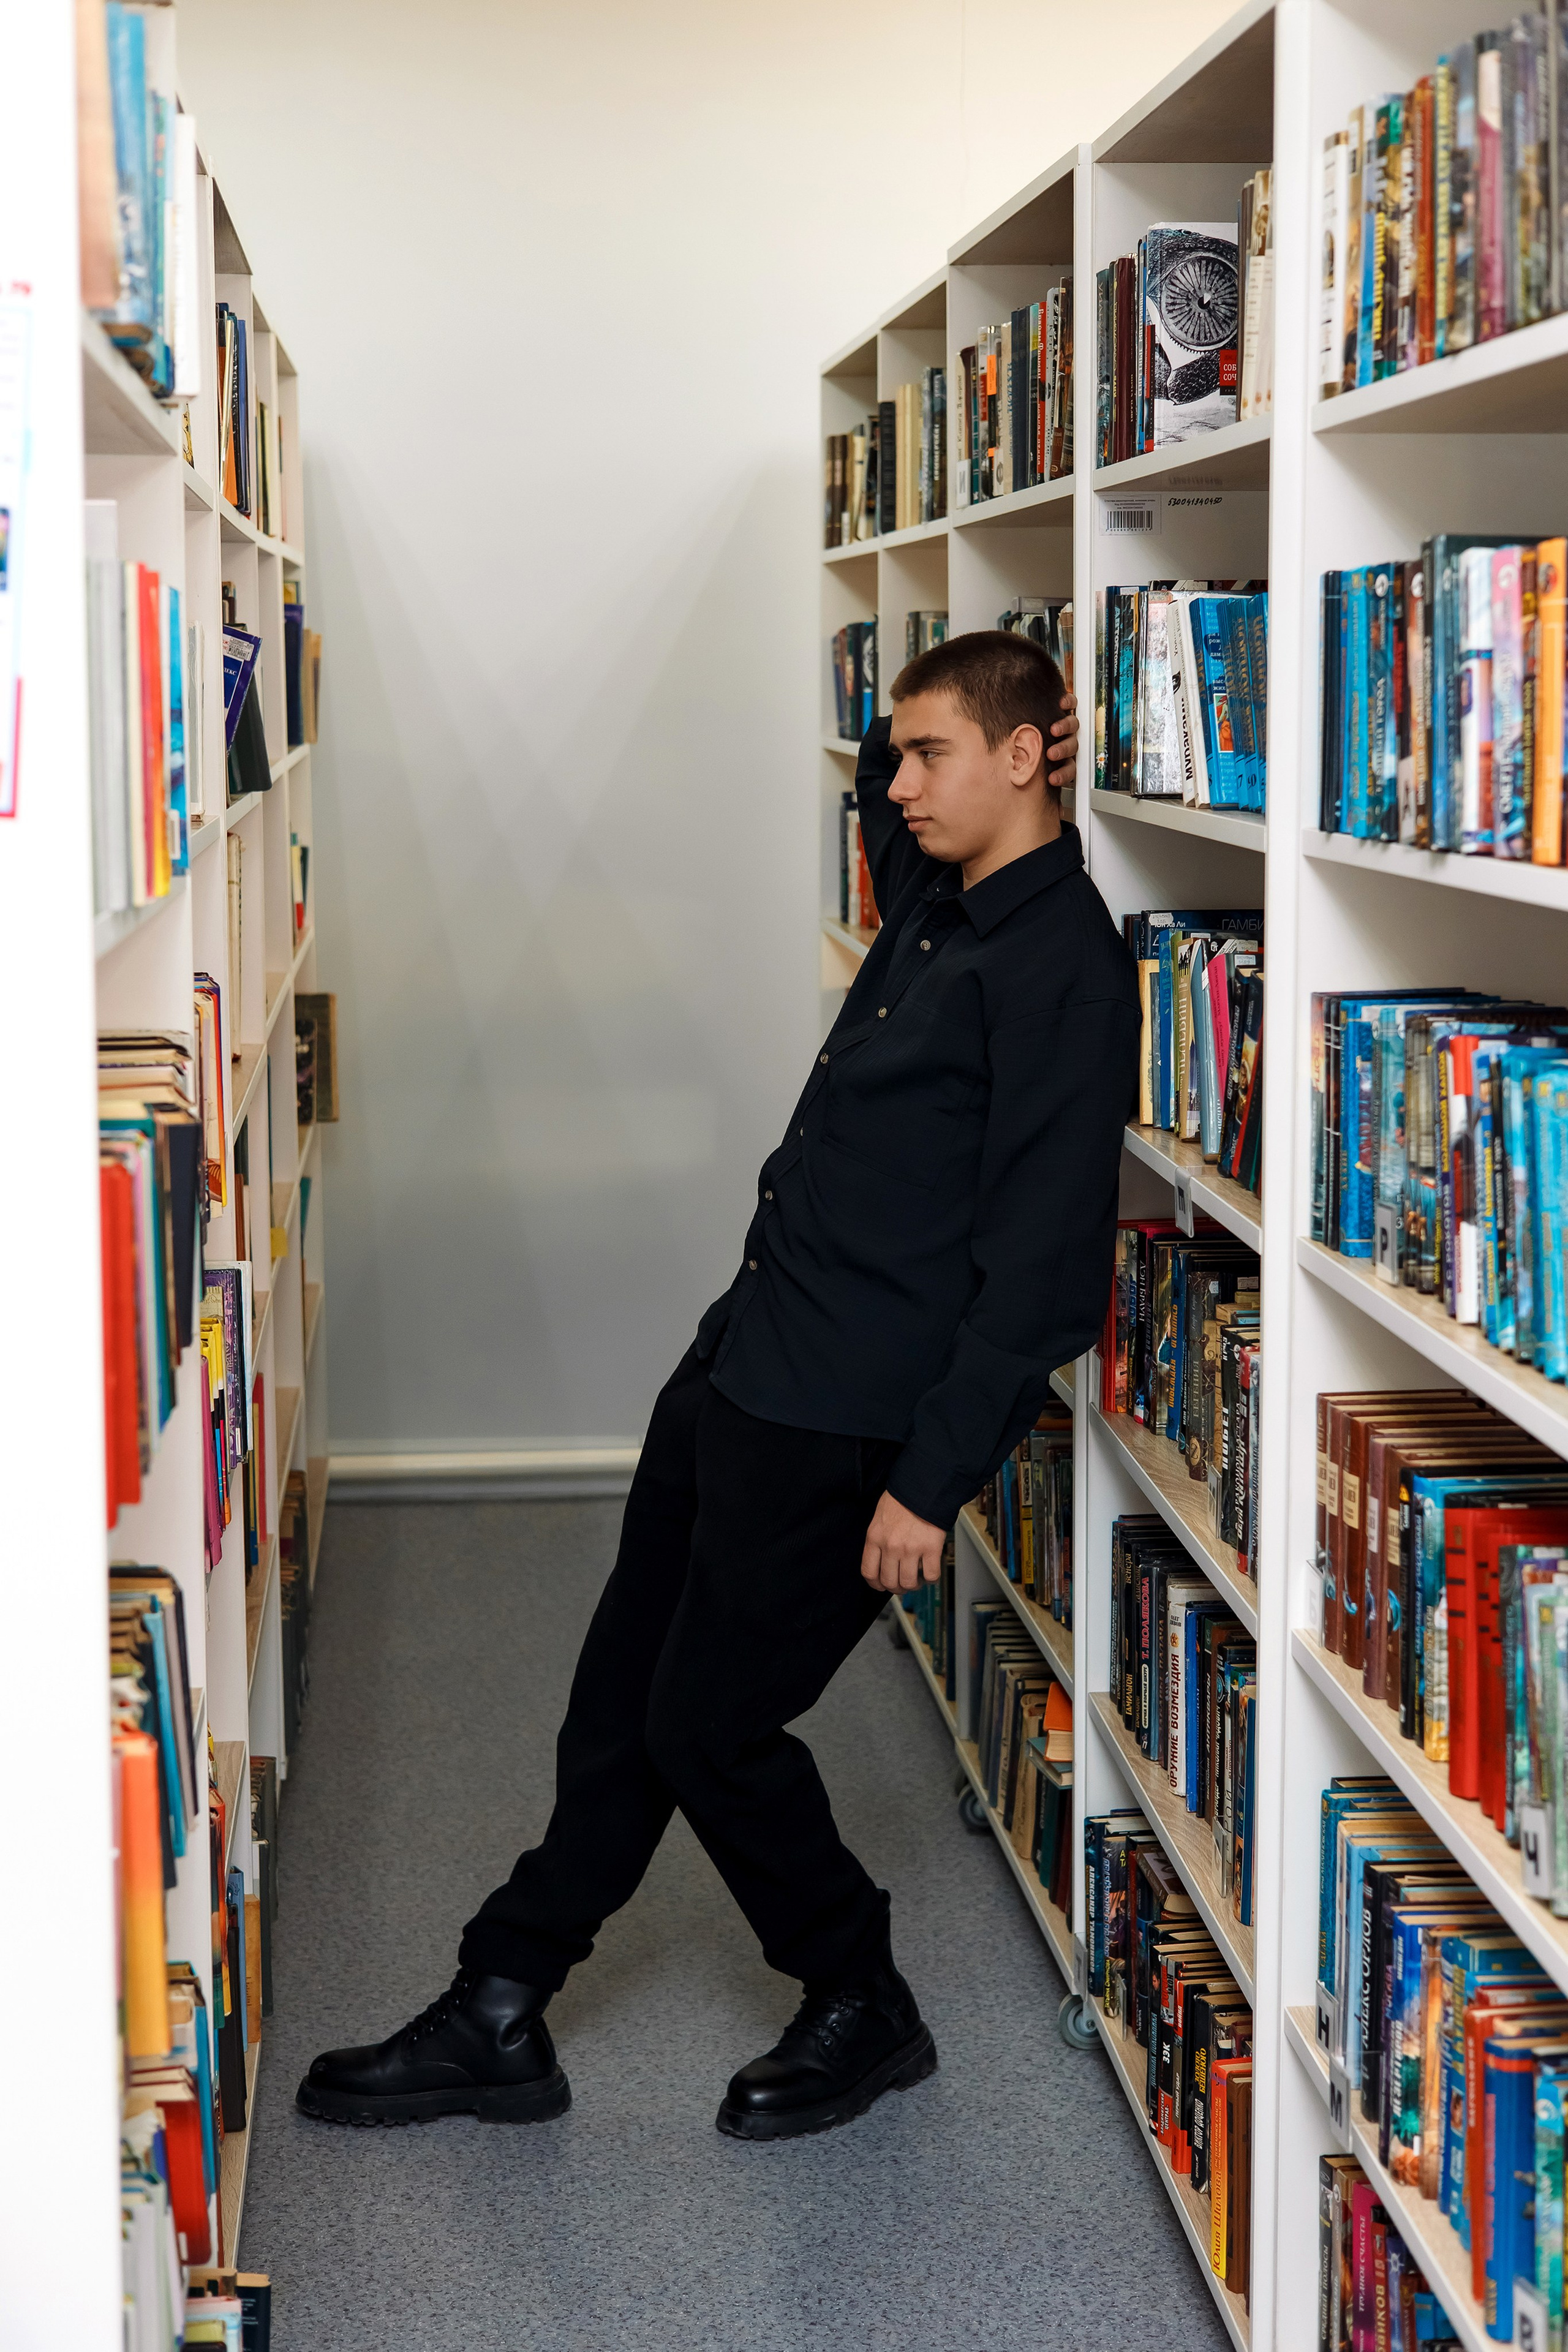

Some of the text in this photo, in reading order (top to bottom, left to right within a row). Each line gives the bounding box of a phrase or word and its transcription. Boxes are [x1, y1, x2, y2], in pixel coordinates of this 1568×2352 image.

[1178, 997, 1187, 1076] ПЕЛЕВИН
[1442, 1183, 1453, 1263] РОКОТОВ
[1141, 1577, 1150, 1660] Т. ПОЛЯКОВА
[1169, 1653, 1181, 1788] ОРУЖИЕ ВОЗМЕЗДИЯ
[1525, 1831, 1539, 1876] Ч
[1361, 1908, 1372, 2049] АЛЕКС ОРЛОВ
[1319, 2005, 1330, 2050] Н
[1194, 2098, 1205, 2128] ДОЦЕНКО
[1330, 2080, 1342, 2129] М
[1194, 2125, 1204, 2150] ВИКТОР
[1213, 2171, 1222, 2228] Шилова
